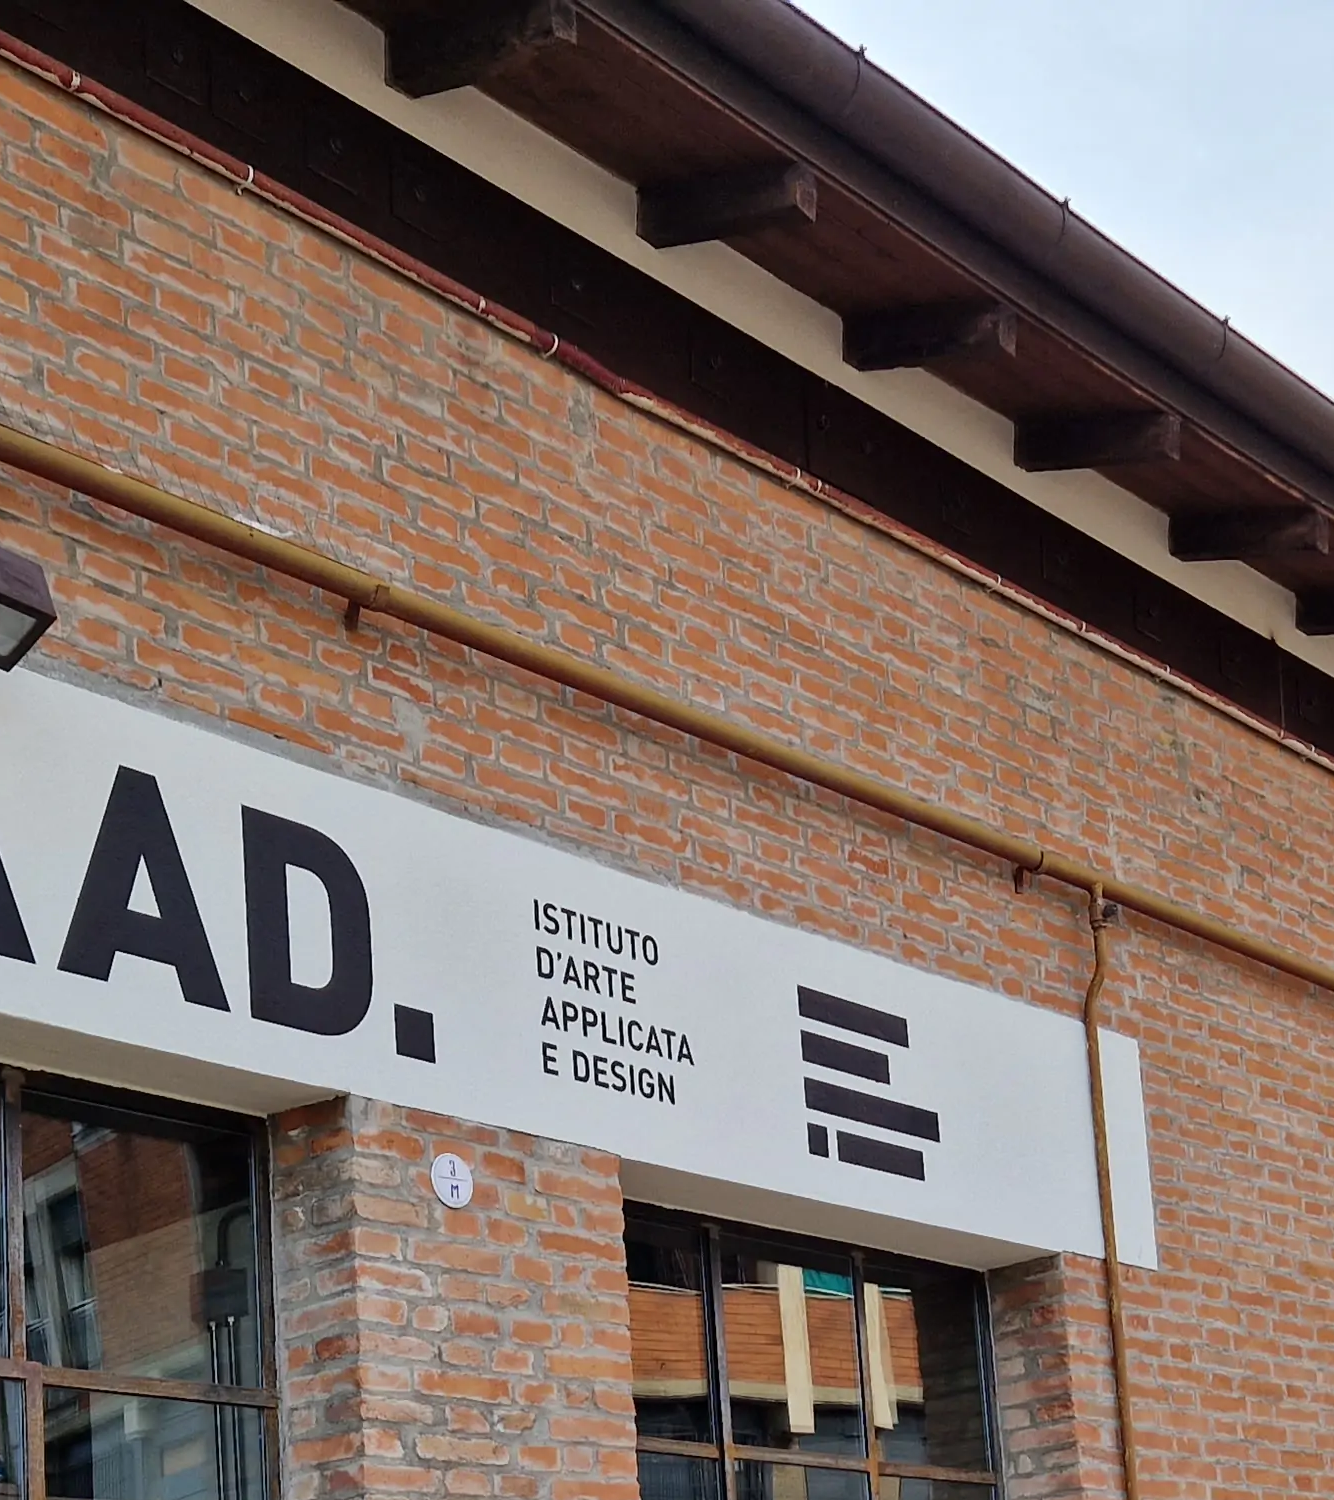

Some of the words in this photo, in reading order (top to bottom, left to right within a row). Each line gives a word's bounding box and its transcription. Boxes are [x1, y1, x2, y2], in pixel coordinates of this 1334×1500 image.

[533, 898, 658, 966] ISTITUTO
[536, 945, 636, 1005] D'ARTE
[541, 996, 695, 1066] APPLICATA
[542, 1041, 559, 1076] E
[572, 1049, 676, 1105] DESIGN
[450, 1183, 460, 1199] M
